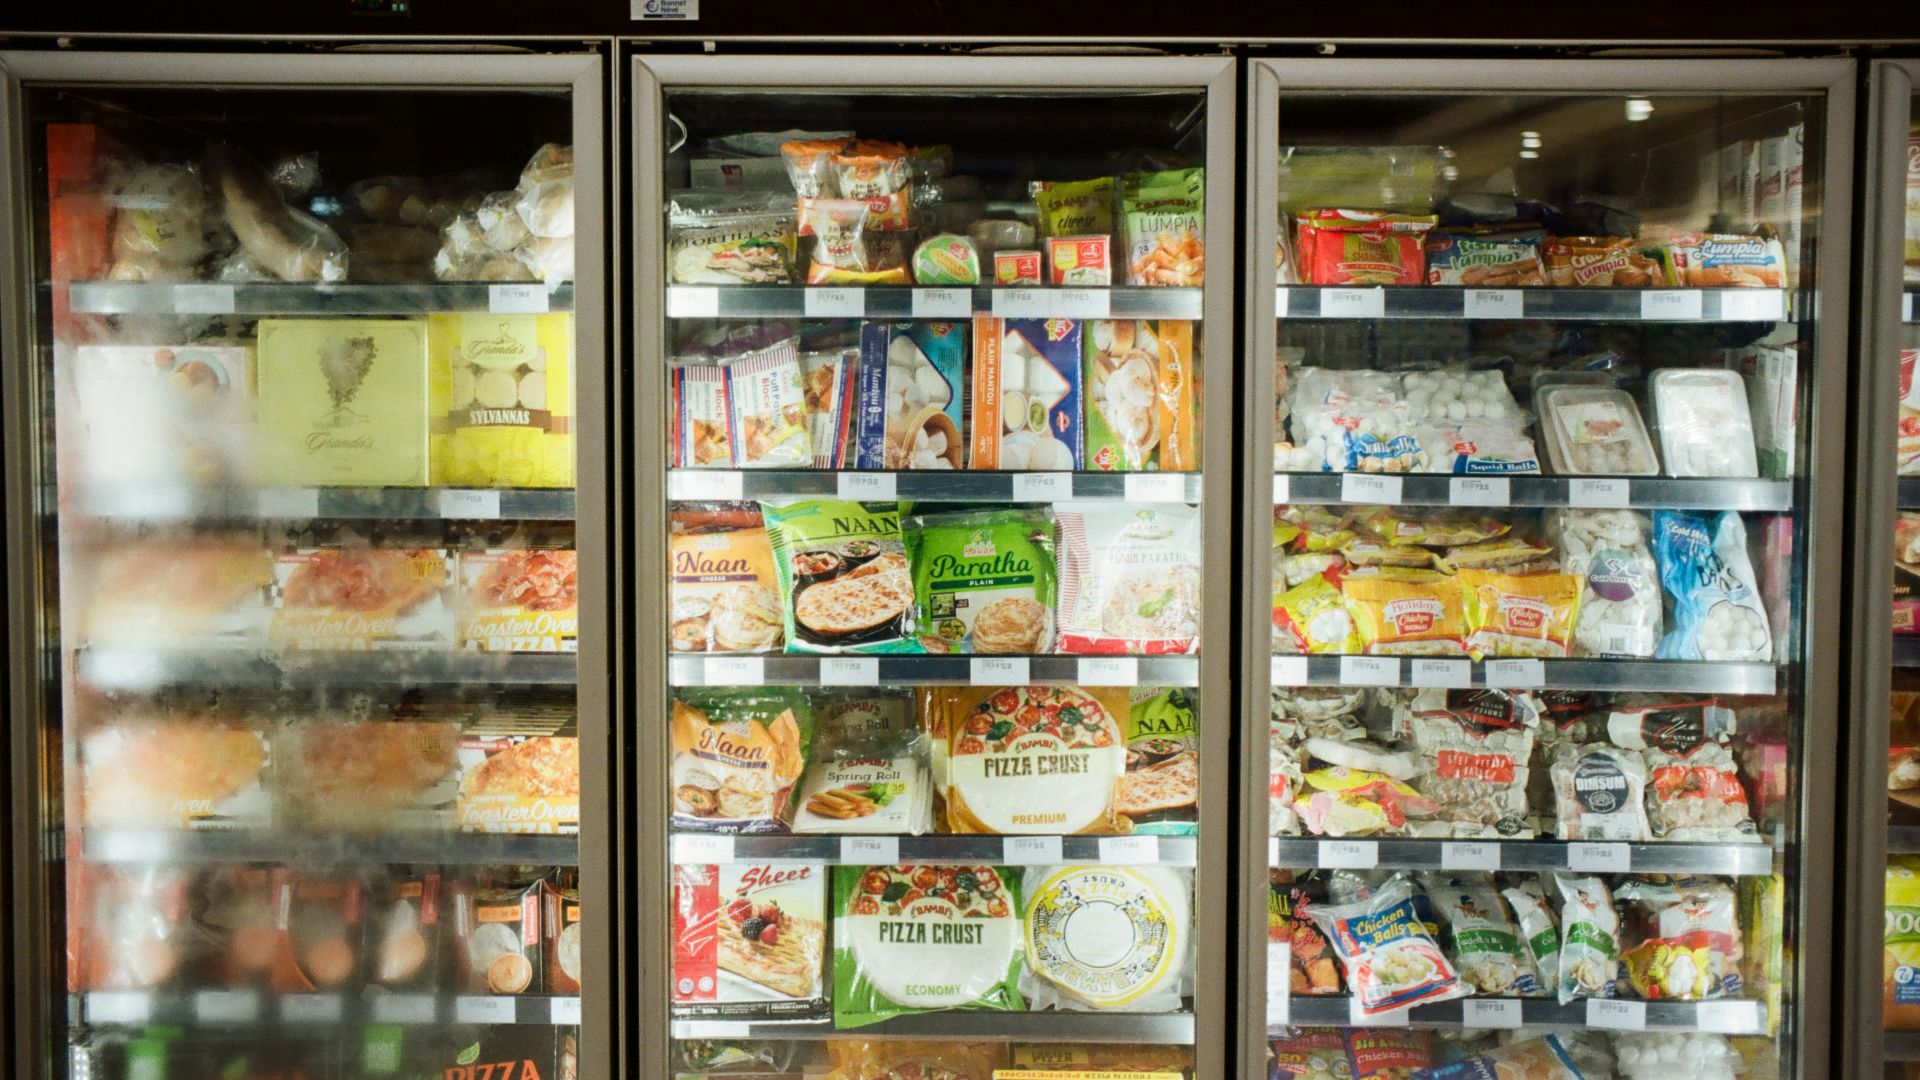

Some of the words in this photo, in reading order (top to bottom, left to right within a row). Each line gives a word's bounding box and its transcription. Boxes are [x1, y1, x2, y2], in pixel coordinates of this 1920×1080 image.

[1139, 215, 1199, 234] LUMPIA
[1692, 240, 1765, 261] Lumpia
[987, 337, 996, 365] PLAIN
[761, 378, 770, 409] Block
[870, 367, 882, 407] Mantou
[986, 366, 996, 406] MANTOU
[715, 388, 724, 419] Block
[469, 410, 530, 425] SYLVANNAS
[1470, 463, 1504, 473] Squid
[1505, 461, 1538, 472] Balls
[832, 516, 899, 535] NAAN
[676, 550, 751, 574] Naan
[929, 550, 1033, 579] Paratha
[700, 575, 727, 583] CHEESE
[969, 578, 994, 587] PLAIN
[1392, 599, 1436, 611] Holiday
[1399, 614, 1430, 625] Chicken
[865, 718, 890, 730] Roll
[699, 728, 763, 759] Naan
[984, 755, 1031, 778] PIZZA
[1037, 753, 1090, 775] CRUST
[827, 771, 872, 783] Spring
[876, 771, 901, 780] Roll
[1575, 775, 1626, 791] DIMSUM
[1012, 813, 1067, 825] PREMIUM
[735, 865, 812, 894] Sheet
[1082, 875, 1126, 888] CRUST
[1356, 908, 1405, 937] Chicken
[879, 921, 926, 944] PIZZA
[932, 923, 984, 945] CRUST
[1373, 923, 1405, 944] Balls
[905, 983, 961, 996] ECONOMY
[1357, 1050, 1403, 1064] Chicken
[444, 1059, 543, 1080] PIZZA
